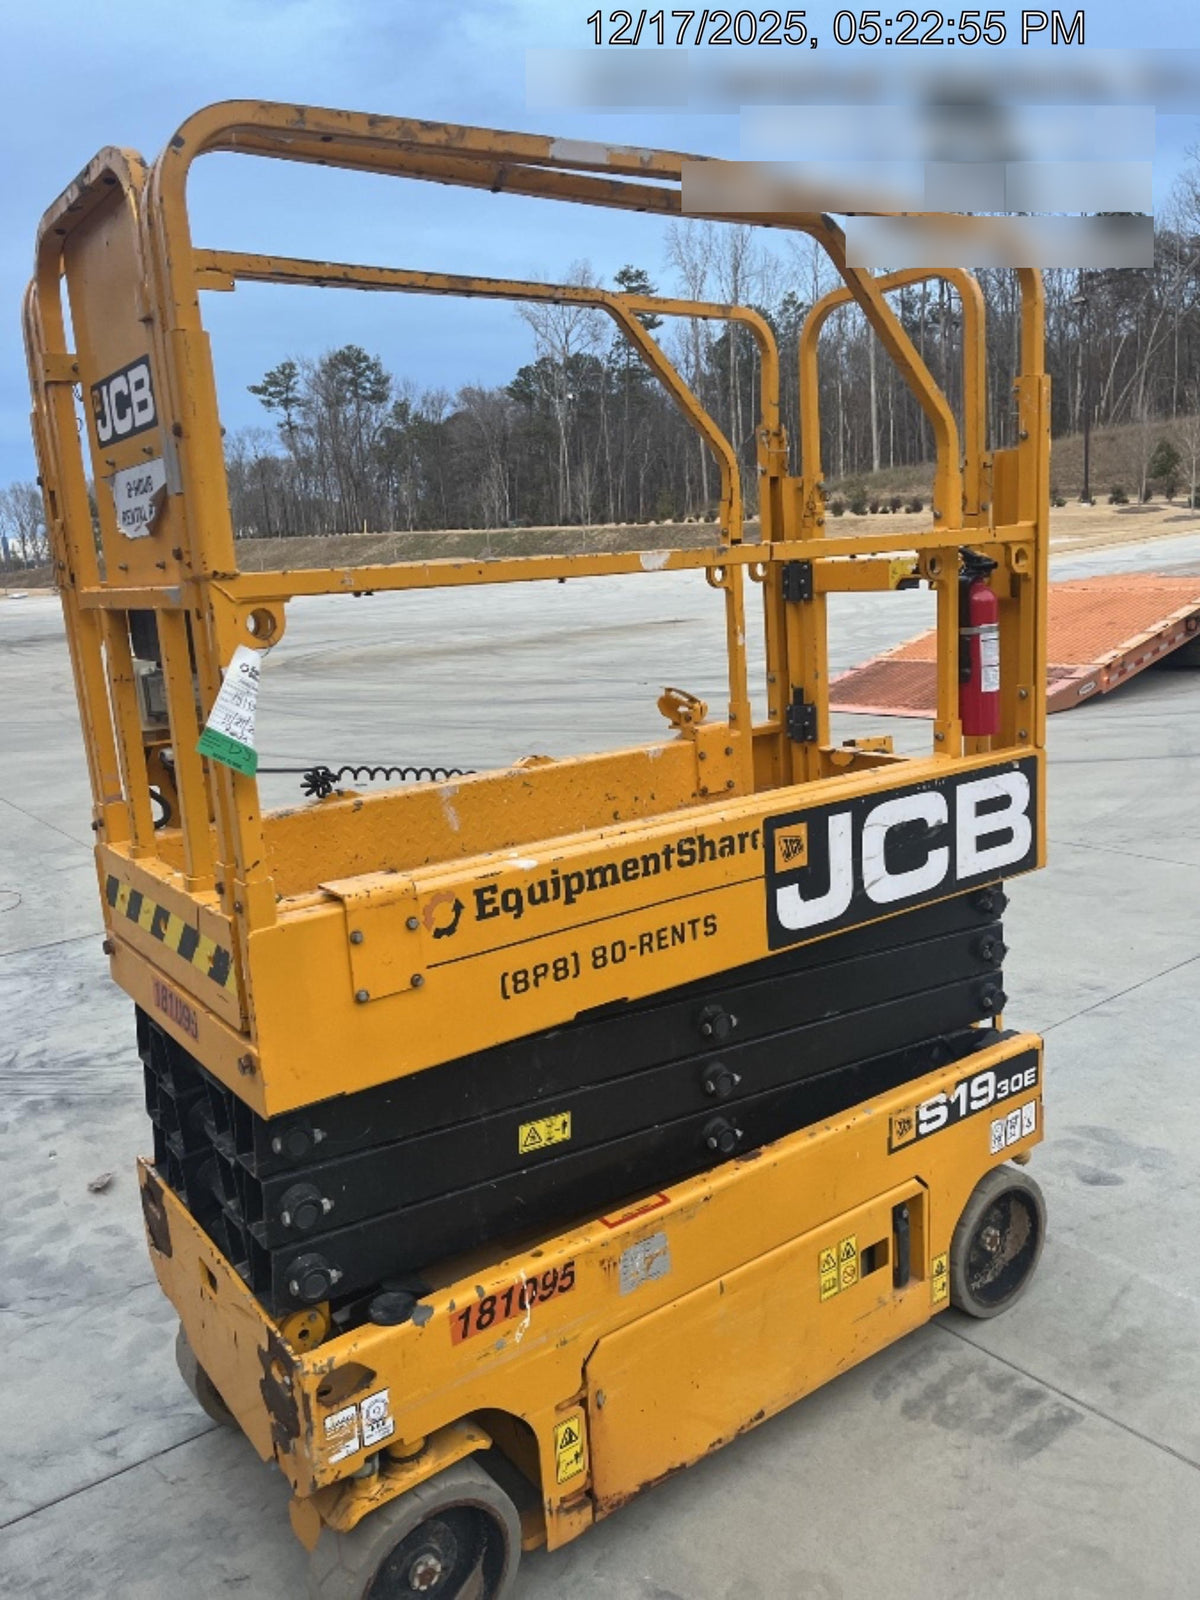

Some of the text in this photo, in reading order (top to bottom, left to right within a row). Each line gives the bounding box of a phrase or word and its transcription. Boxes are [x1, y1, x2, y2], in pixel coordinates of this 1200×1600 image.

[97, 363, 155, 442] JCB
[775, 770, 1033, 931] JCB
[591, 913, 718, 970] 80-RENTS
[457, 1260, 576, 1340] 181095
